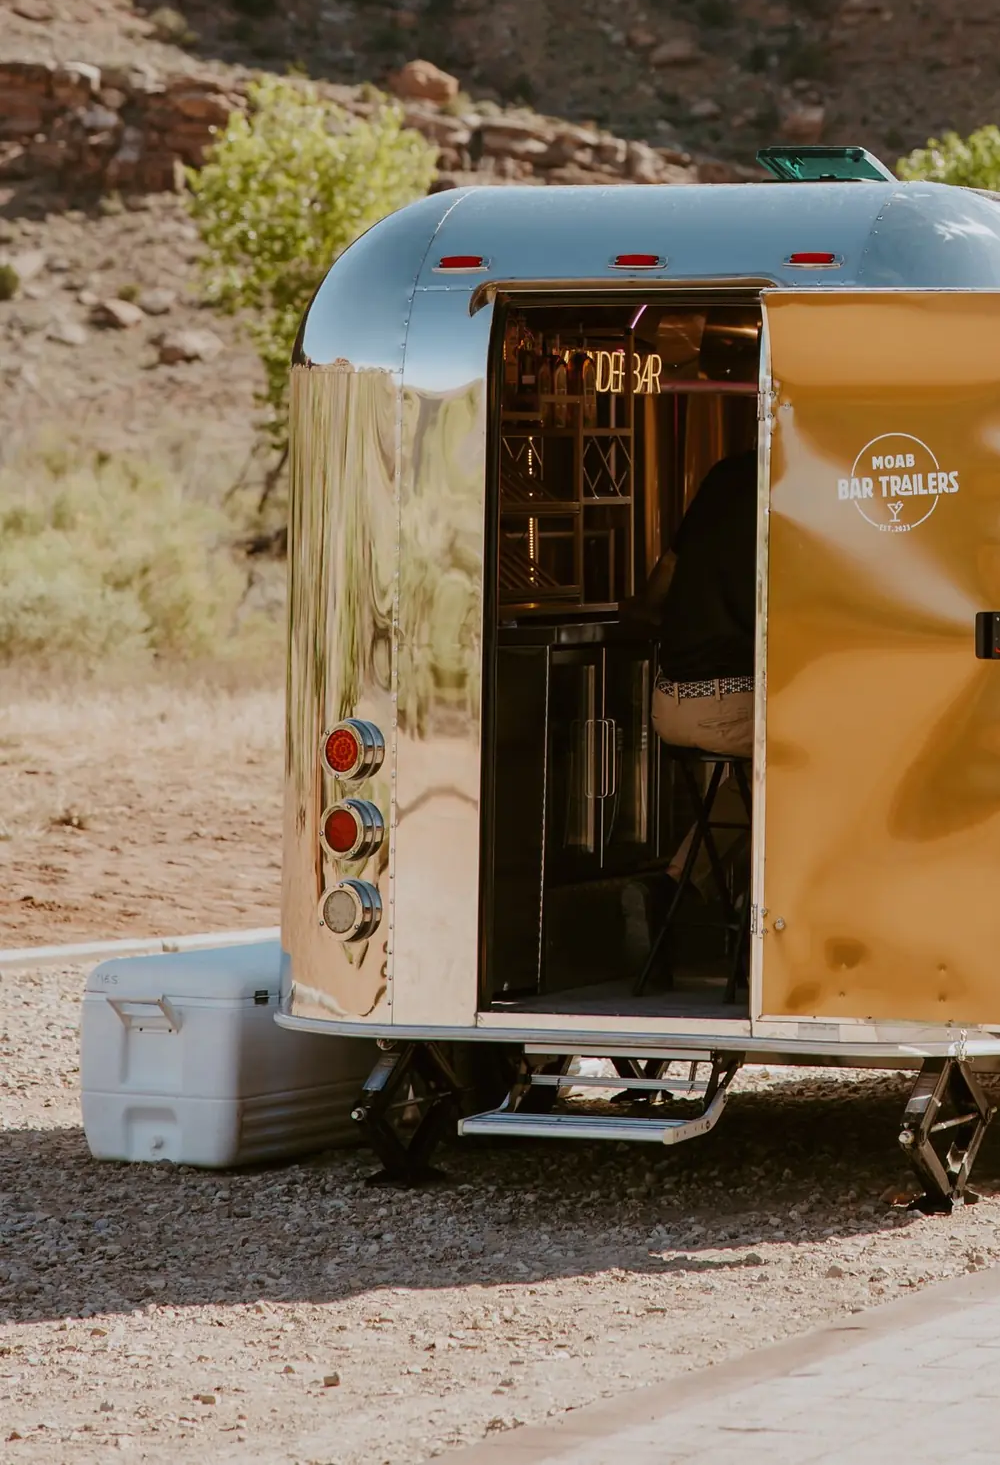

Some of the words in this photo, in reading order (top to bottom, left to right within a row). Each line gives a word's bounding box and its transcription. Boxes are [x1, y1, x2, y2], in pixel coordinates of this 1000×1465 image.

[872, 454, 915, 469] MOAB
[838, 477, 873, 500] BAR
[879, 471, 959, 497] TRAILERS
